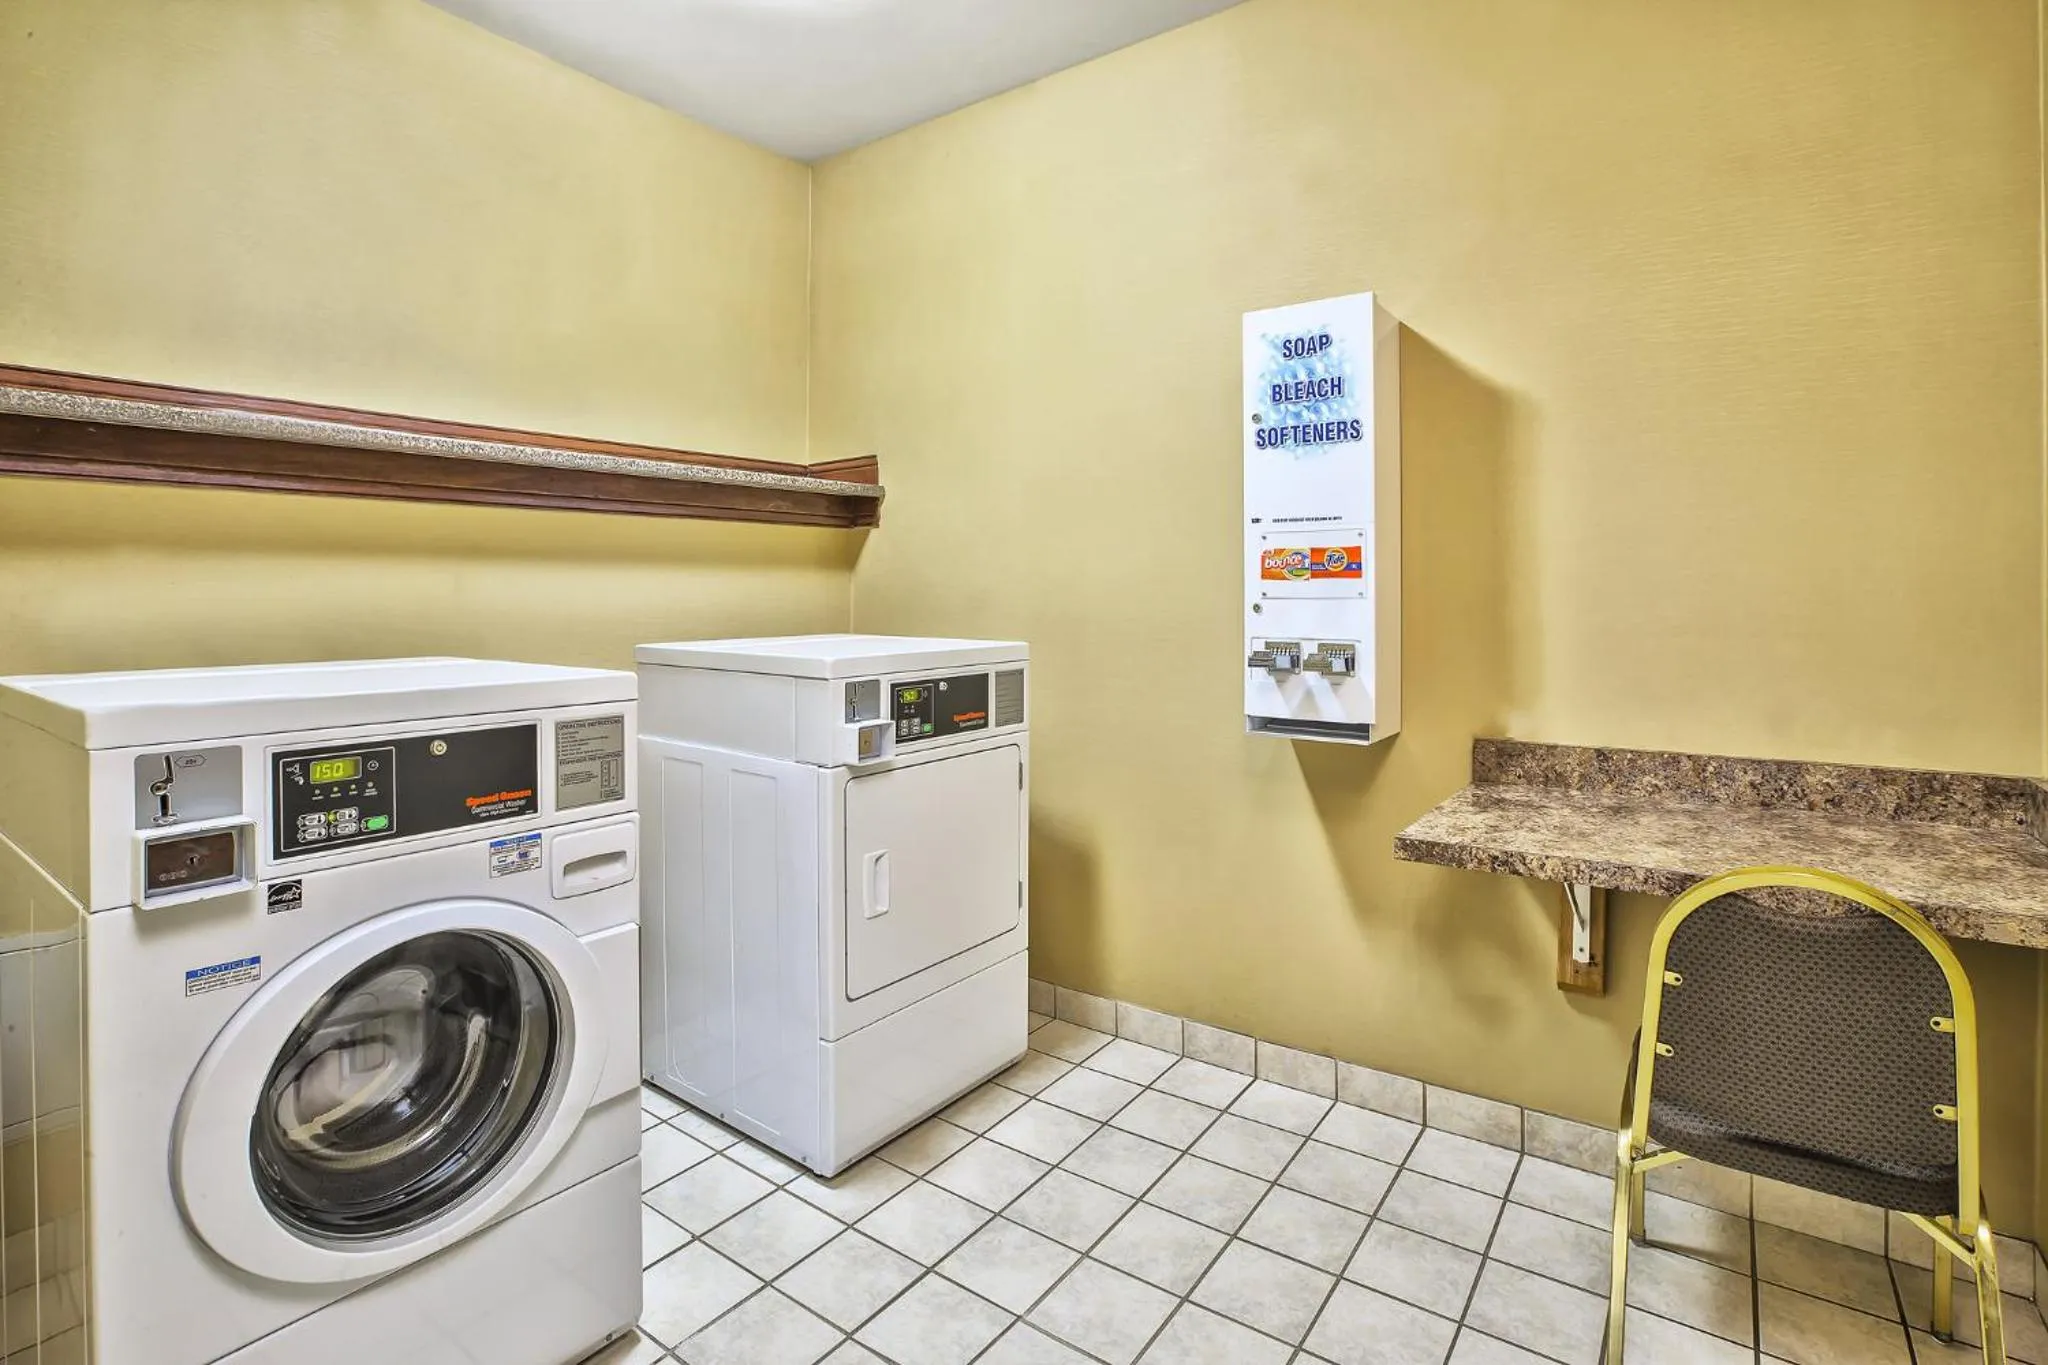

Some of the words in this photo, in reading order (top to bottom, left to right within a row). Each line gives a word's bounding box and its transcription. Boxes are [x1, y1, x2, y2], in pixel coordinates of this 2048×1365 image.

[1282, 334, 1332, 359] SOAP
[1271, 376, 1345, 404] BLEACH
[1256, 418, 1363, 449] SOFTENERS
[315, 761, 345, 779] 150
[197, 959, 251, 977] NOTICE
